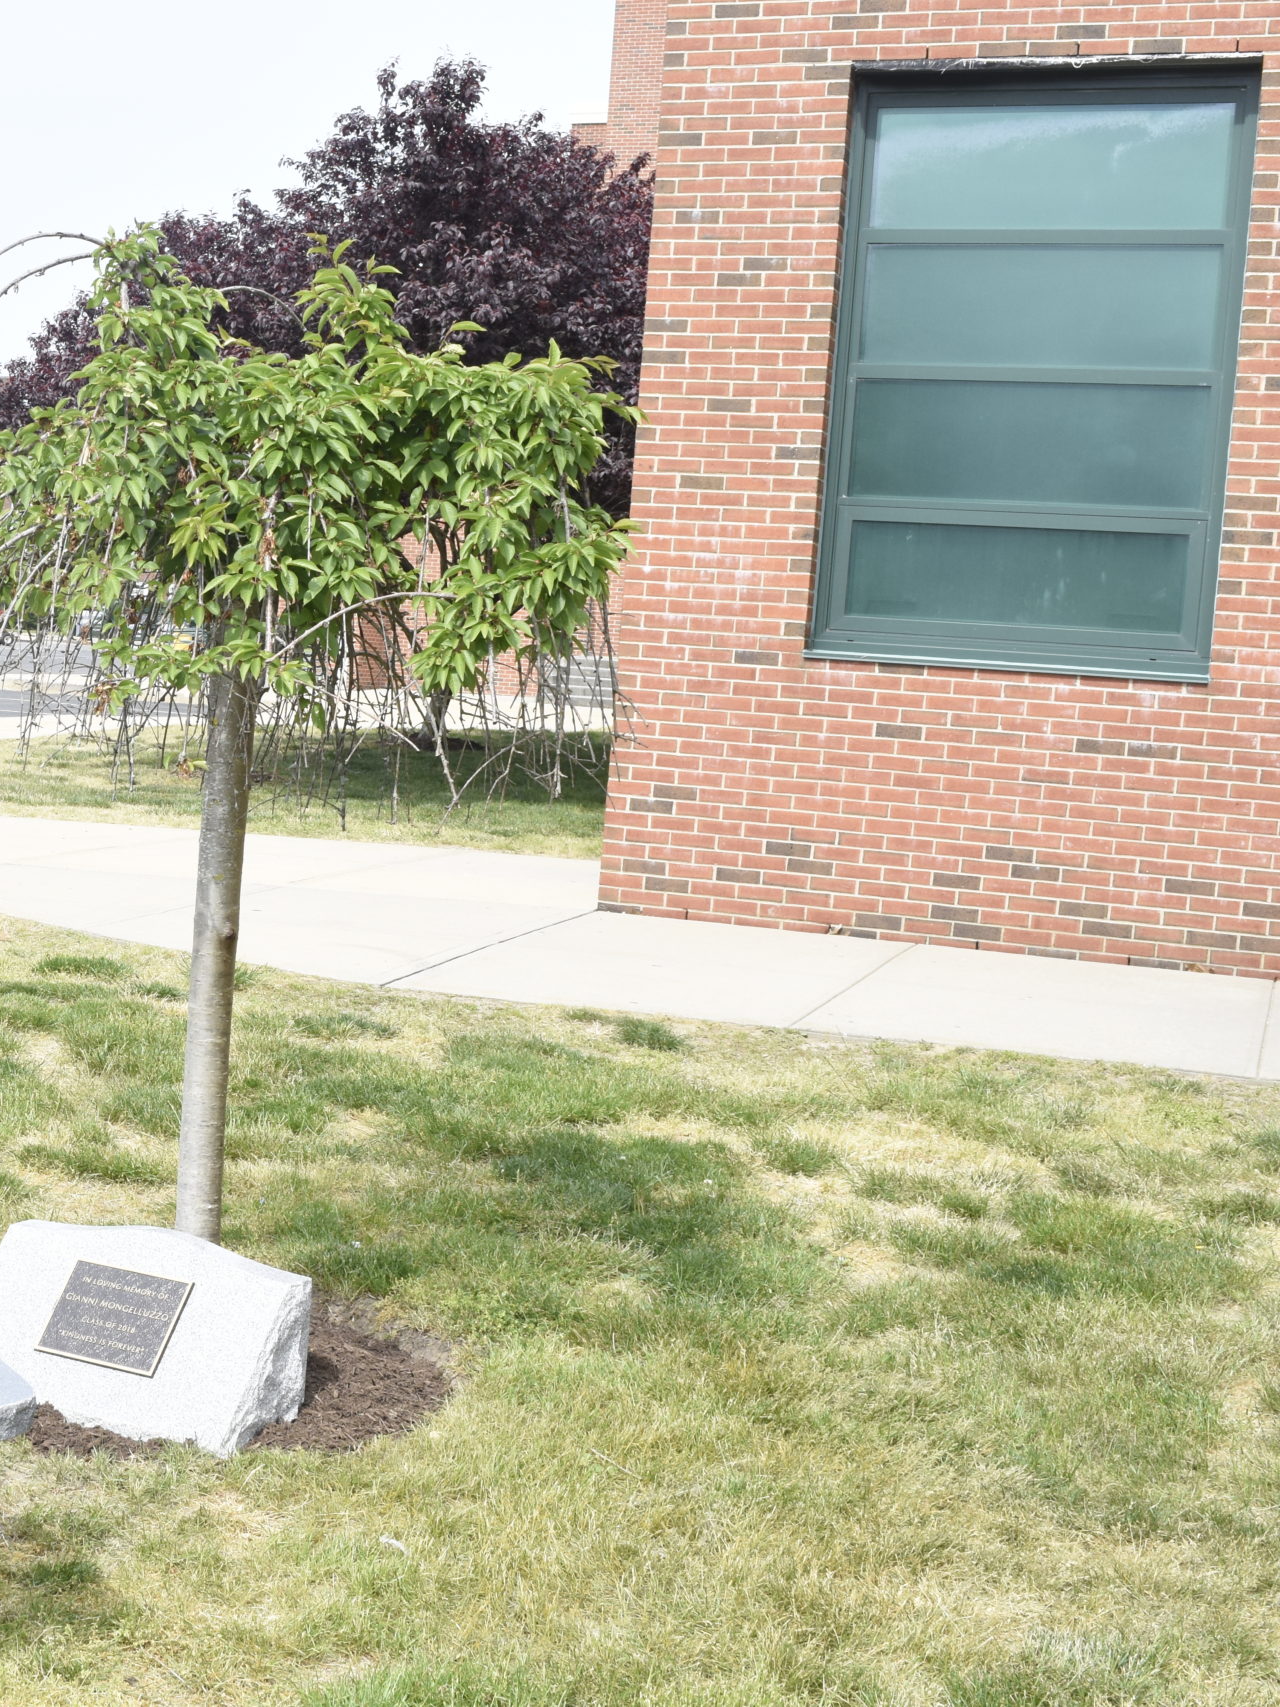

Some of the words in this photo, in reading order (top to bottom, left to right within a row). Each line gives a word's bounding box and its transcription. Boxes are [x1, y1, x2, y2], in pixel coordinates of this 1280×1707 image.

[93, 1278, 122, 1290] LOVING
[123, 1285, 155, 1297] MEMORY
[157, 1291, 169, 1300] OF
[65, 1292, 98, 1306] GIANNI
[100, 1300, 168, 1322] MONGELLUZZO
[82, 1316, 103, 1326] CLASS
[105, 1322, 116, 1330] OF
[98, 1338, 106, 1346] IS
